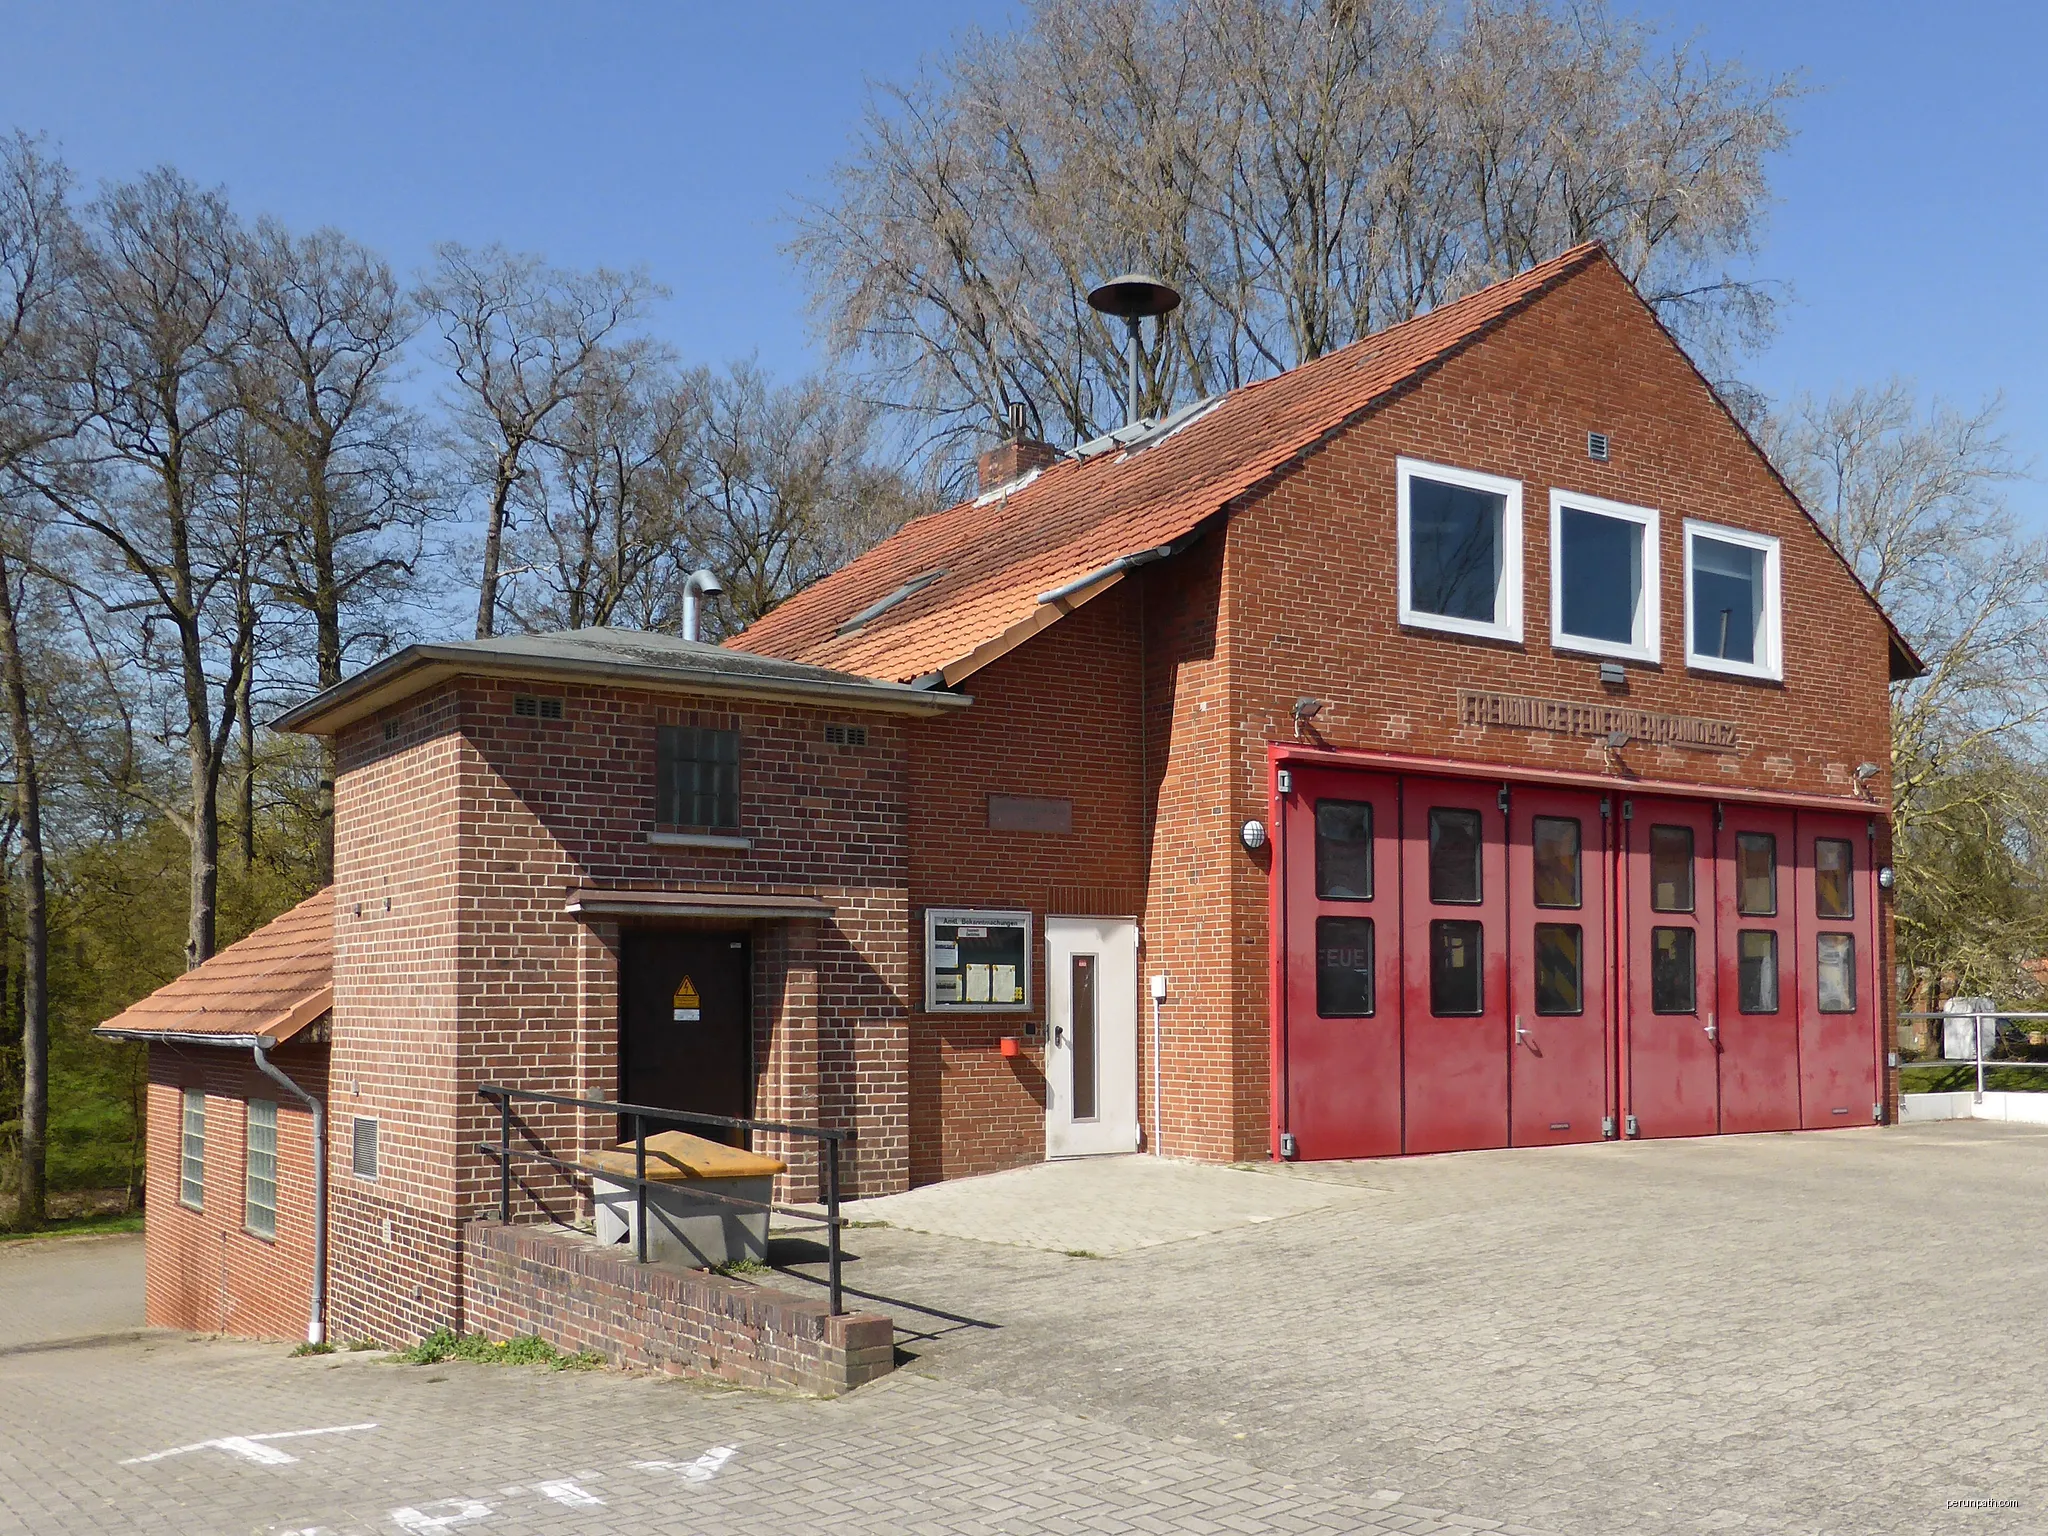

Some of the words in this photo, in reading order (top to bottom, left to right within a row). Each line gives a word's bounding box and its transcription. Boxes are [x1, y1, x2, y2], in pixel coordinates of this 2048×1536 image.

[1462, 694, 1568, 731] FREIWILLIGE
[1570, 706, 1667, 742] FEUERWEHR
[961, 918, 1018, 927] Bekanntmachungen
